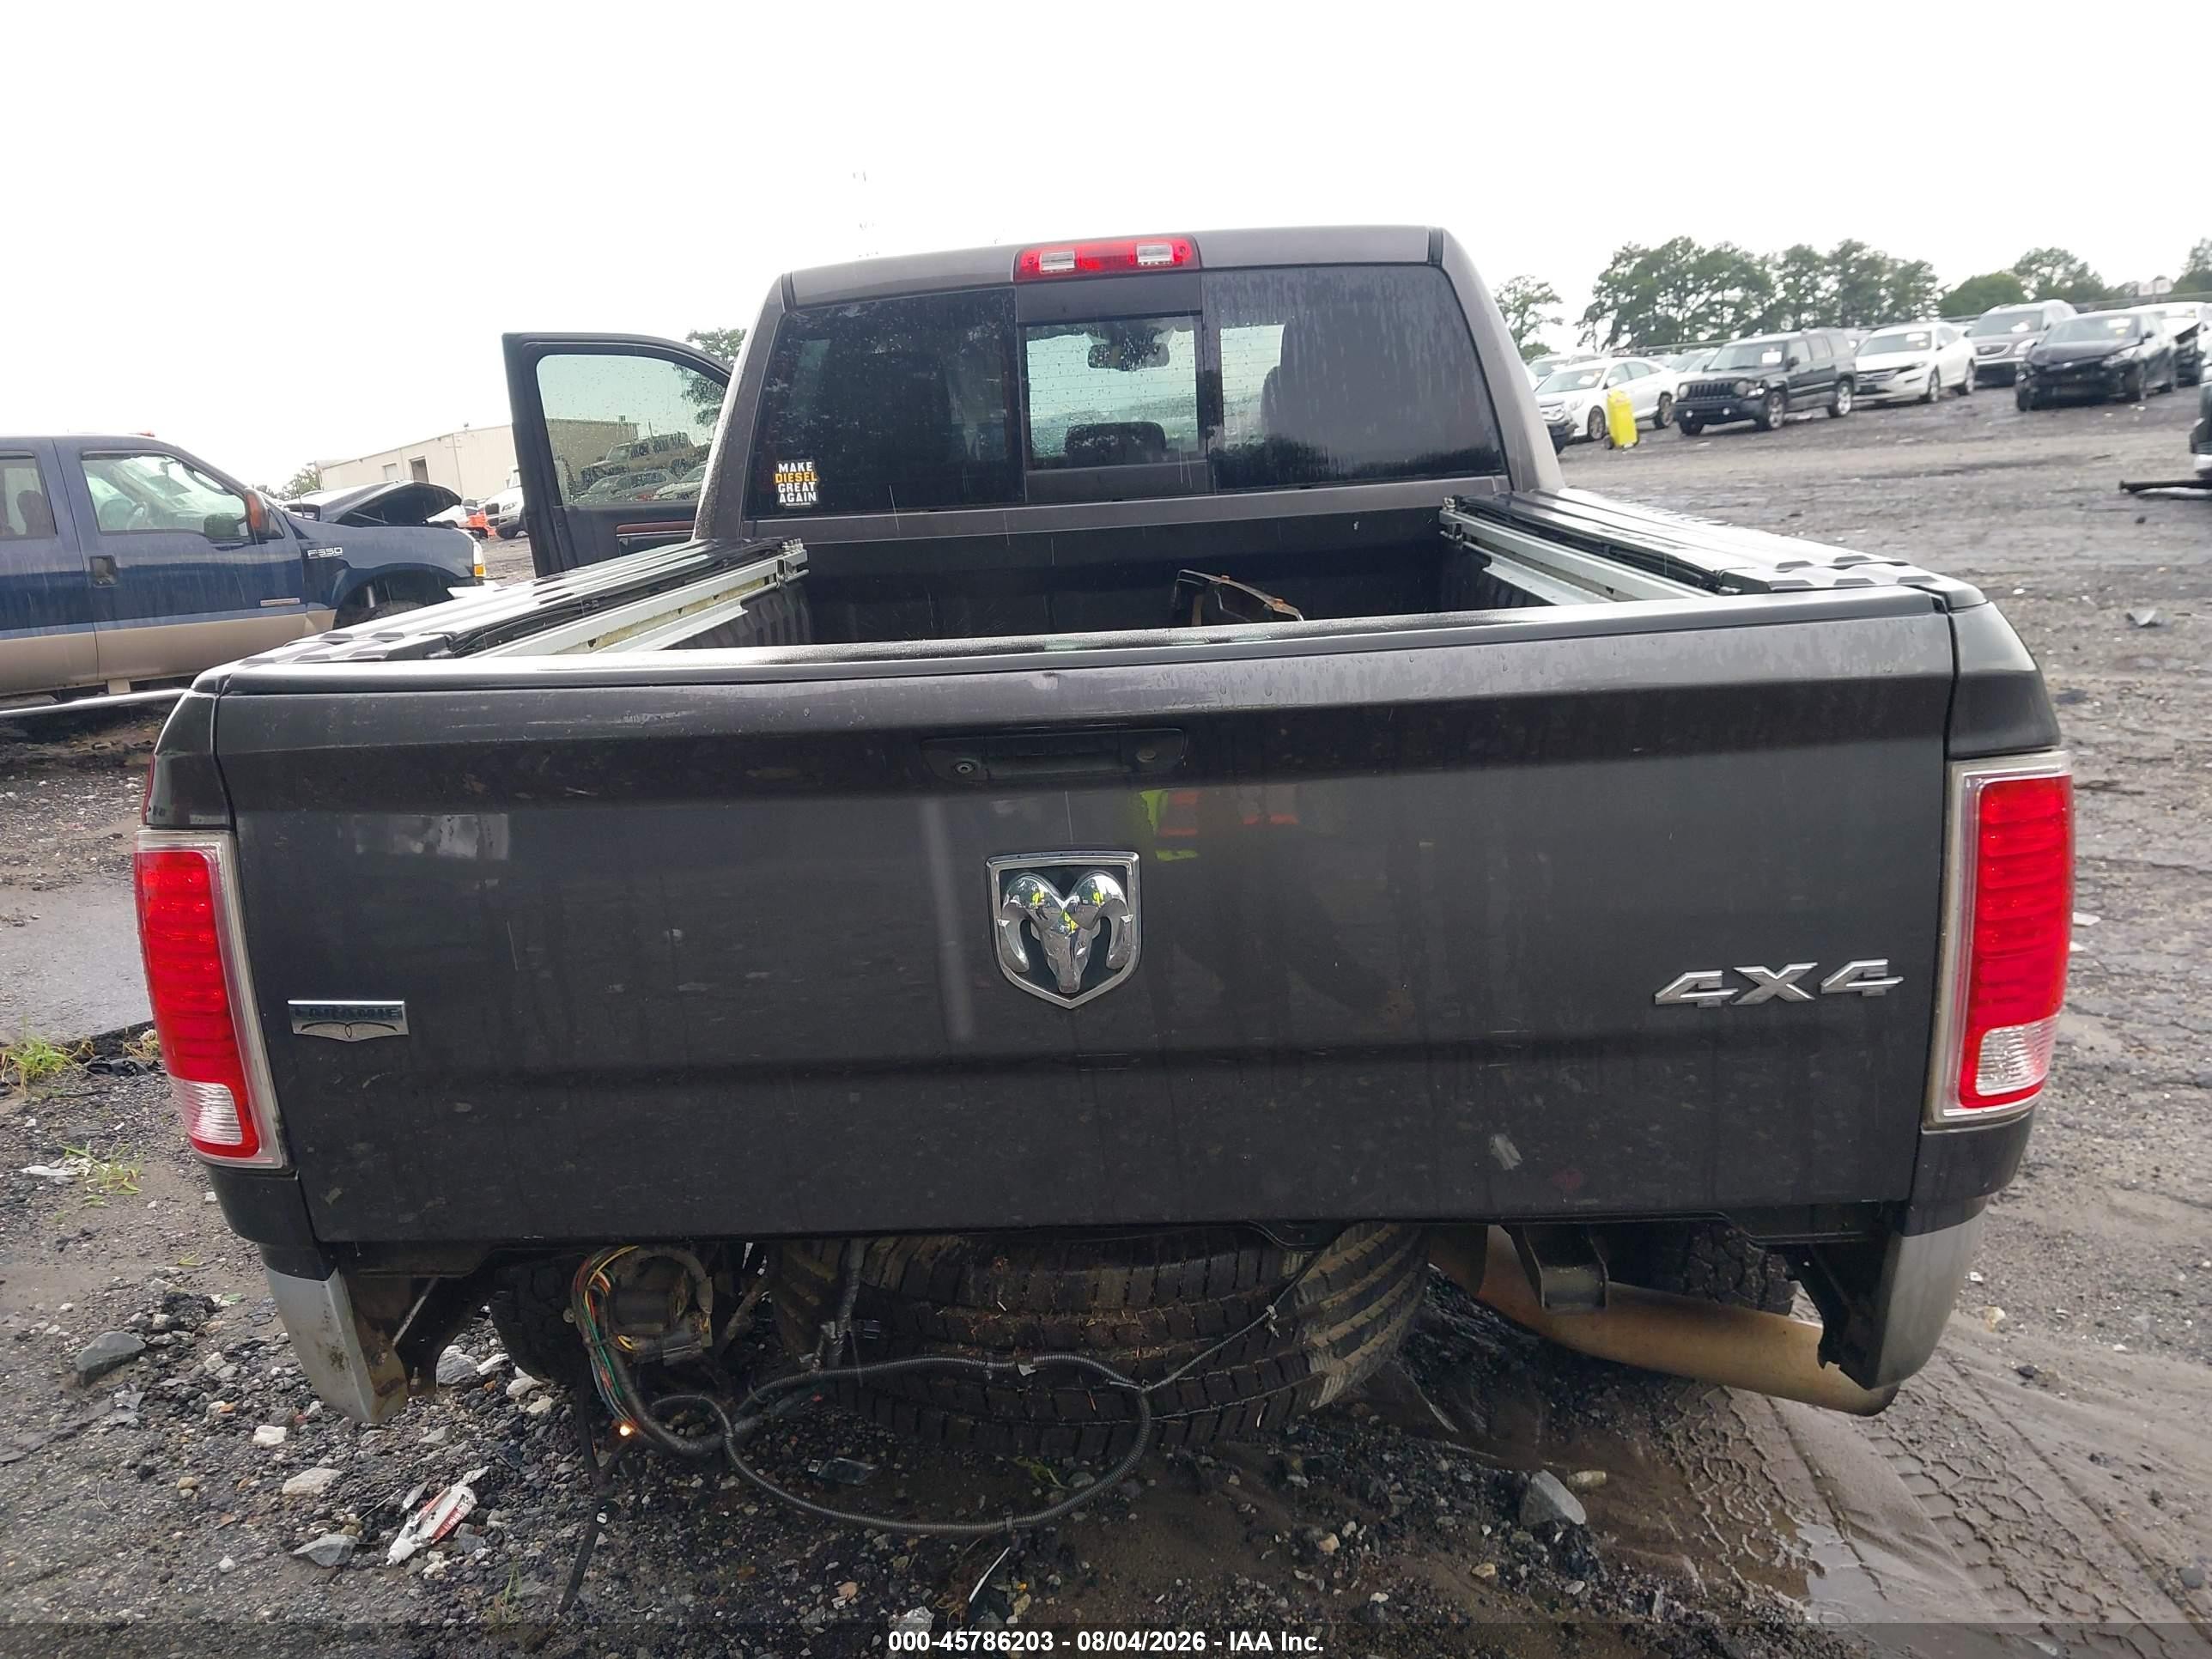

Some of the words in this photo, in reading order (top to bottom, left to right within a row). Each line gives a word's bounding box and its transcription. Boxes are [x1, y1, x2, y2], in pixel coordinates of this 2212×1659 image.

[778, 461, 813, 473] MAKE
[775, 471, 817, 483] DIESEL
[778, 481, 816, 493] GREAT
[779, 491, 817, 503] AGAIN
[1655, 958, 1904, 1008] 4X4
